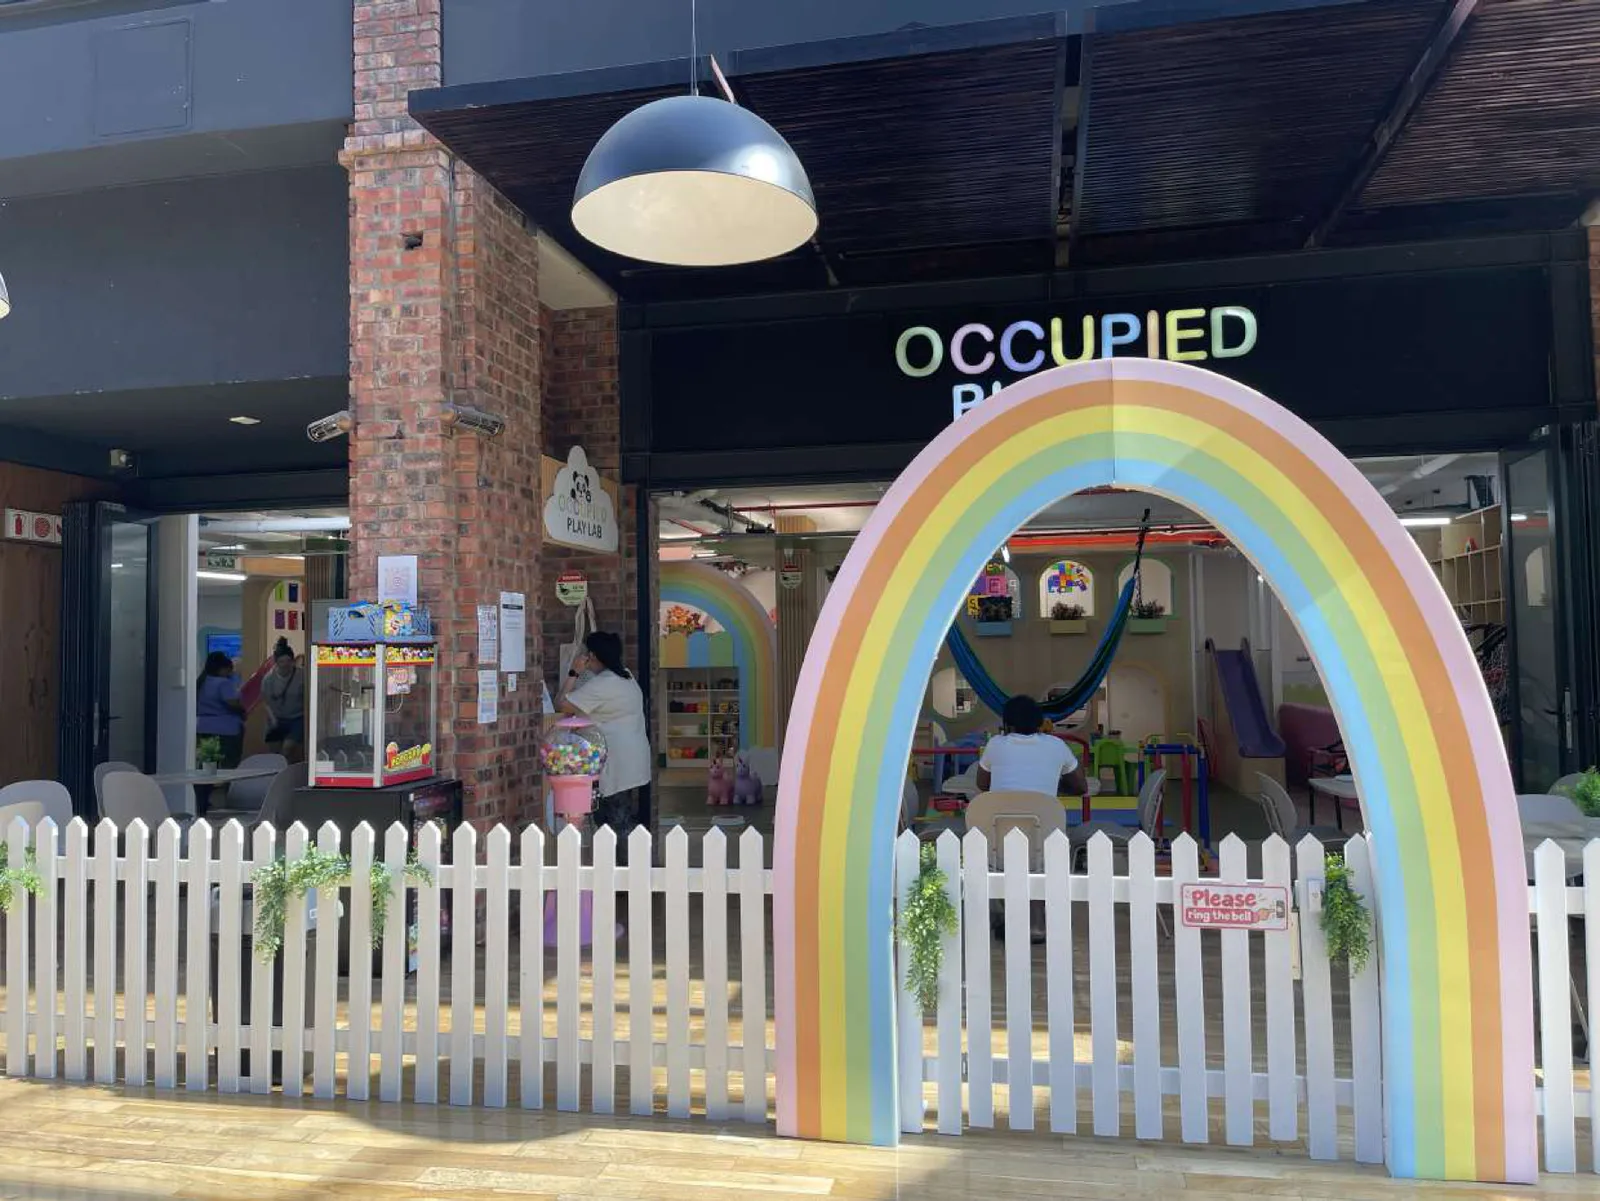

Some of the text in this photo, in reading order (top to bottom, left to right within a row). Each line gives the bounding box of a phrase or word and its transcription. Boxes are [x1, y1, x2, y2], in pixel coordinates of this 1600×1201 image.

[895, 306, 1257, 377] OCCUPIED
[567, 516, 602, 539] PLAY LAB
[1192, 888, 1256, 906] Please
[1188, 909, 1252, 923] ring the bell
